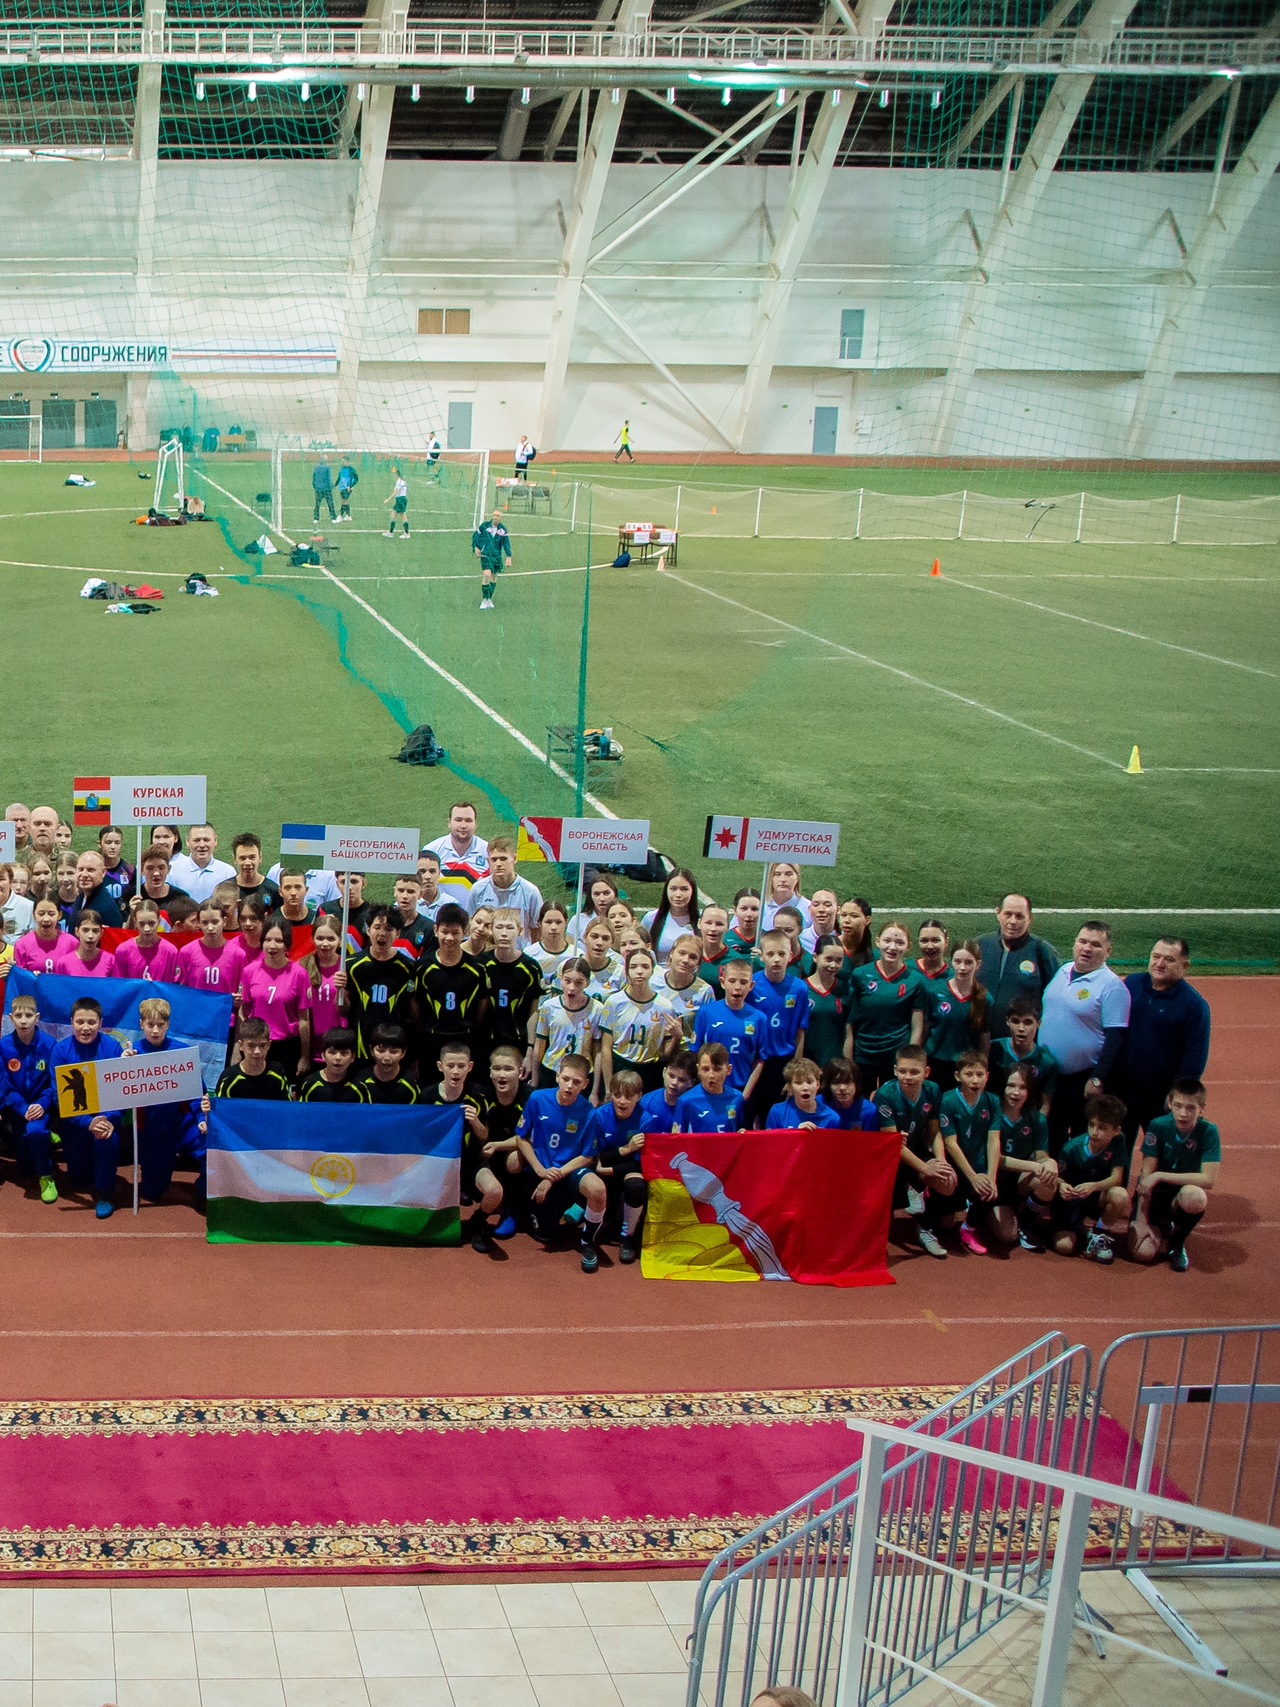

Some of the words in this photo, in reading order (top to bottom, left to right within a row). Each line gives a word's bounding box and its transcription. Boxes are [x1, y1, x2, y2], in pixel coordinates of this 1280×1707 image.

[61, 345, 168, 362] СООРУЖЕНИЯ
[132, 787, 184, 798] КУРСКАЯ
[132, 806, 184, 817] ОБЛАСТЬ
[568, 831, 643, 841] ВОРОНЕЖСКАЯ
[757, 830, 833, 843] УДМУРТСКАЯ
[339, 839, 406, 850] РЕСПУБЛИКА
[581, 842, 628, 851] ОБЛАСТЬ
[755, 842, 831, 855] РЕСПУБЛИКА
[330, 849, 414, 861] БАШКОРТОСТАН
[105, 883, 122, 898] 10
[204, 966, 220, 984] 10
[267, 986, 277, 1004] 7
[371, 984, 388, 1003] 10
[445, 991, 456, 1010] 8
[498, 988, 509, 1007] 5
[771, 1012, 780, 1027] 6
[730, 1037, 740, 1053] 2
[103, 1061, 194, 1083] ЯРОСЛАВСКАЯ
[122, 1080, 179, 1096] ОБЛАСТЬ
[550, 1133, 560, 1148] 8
